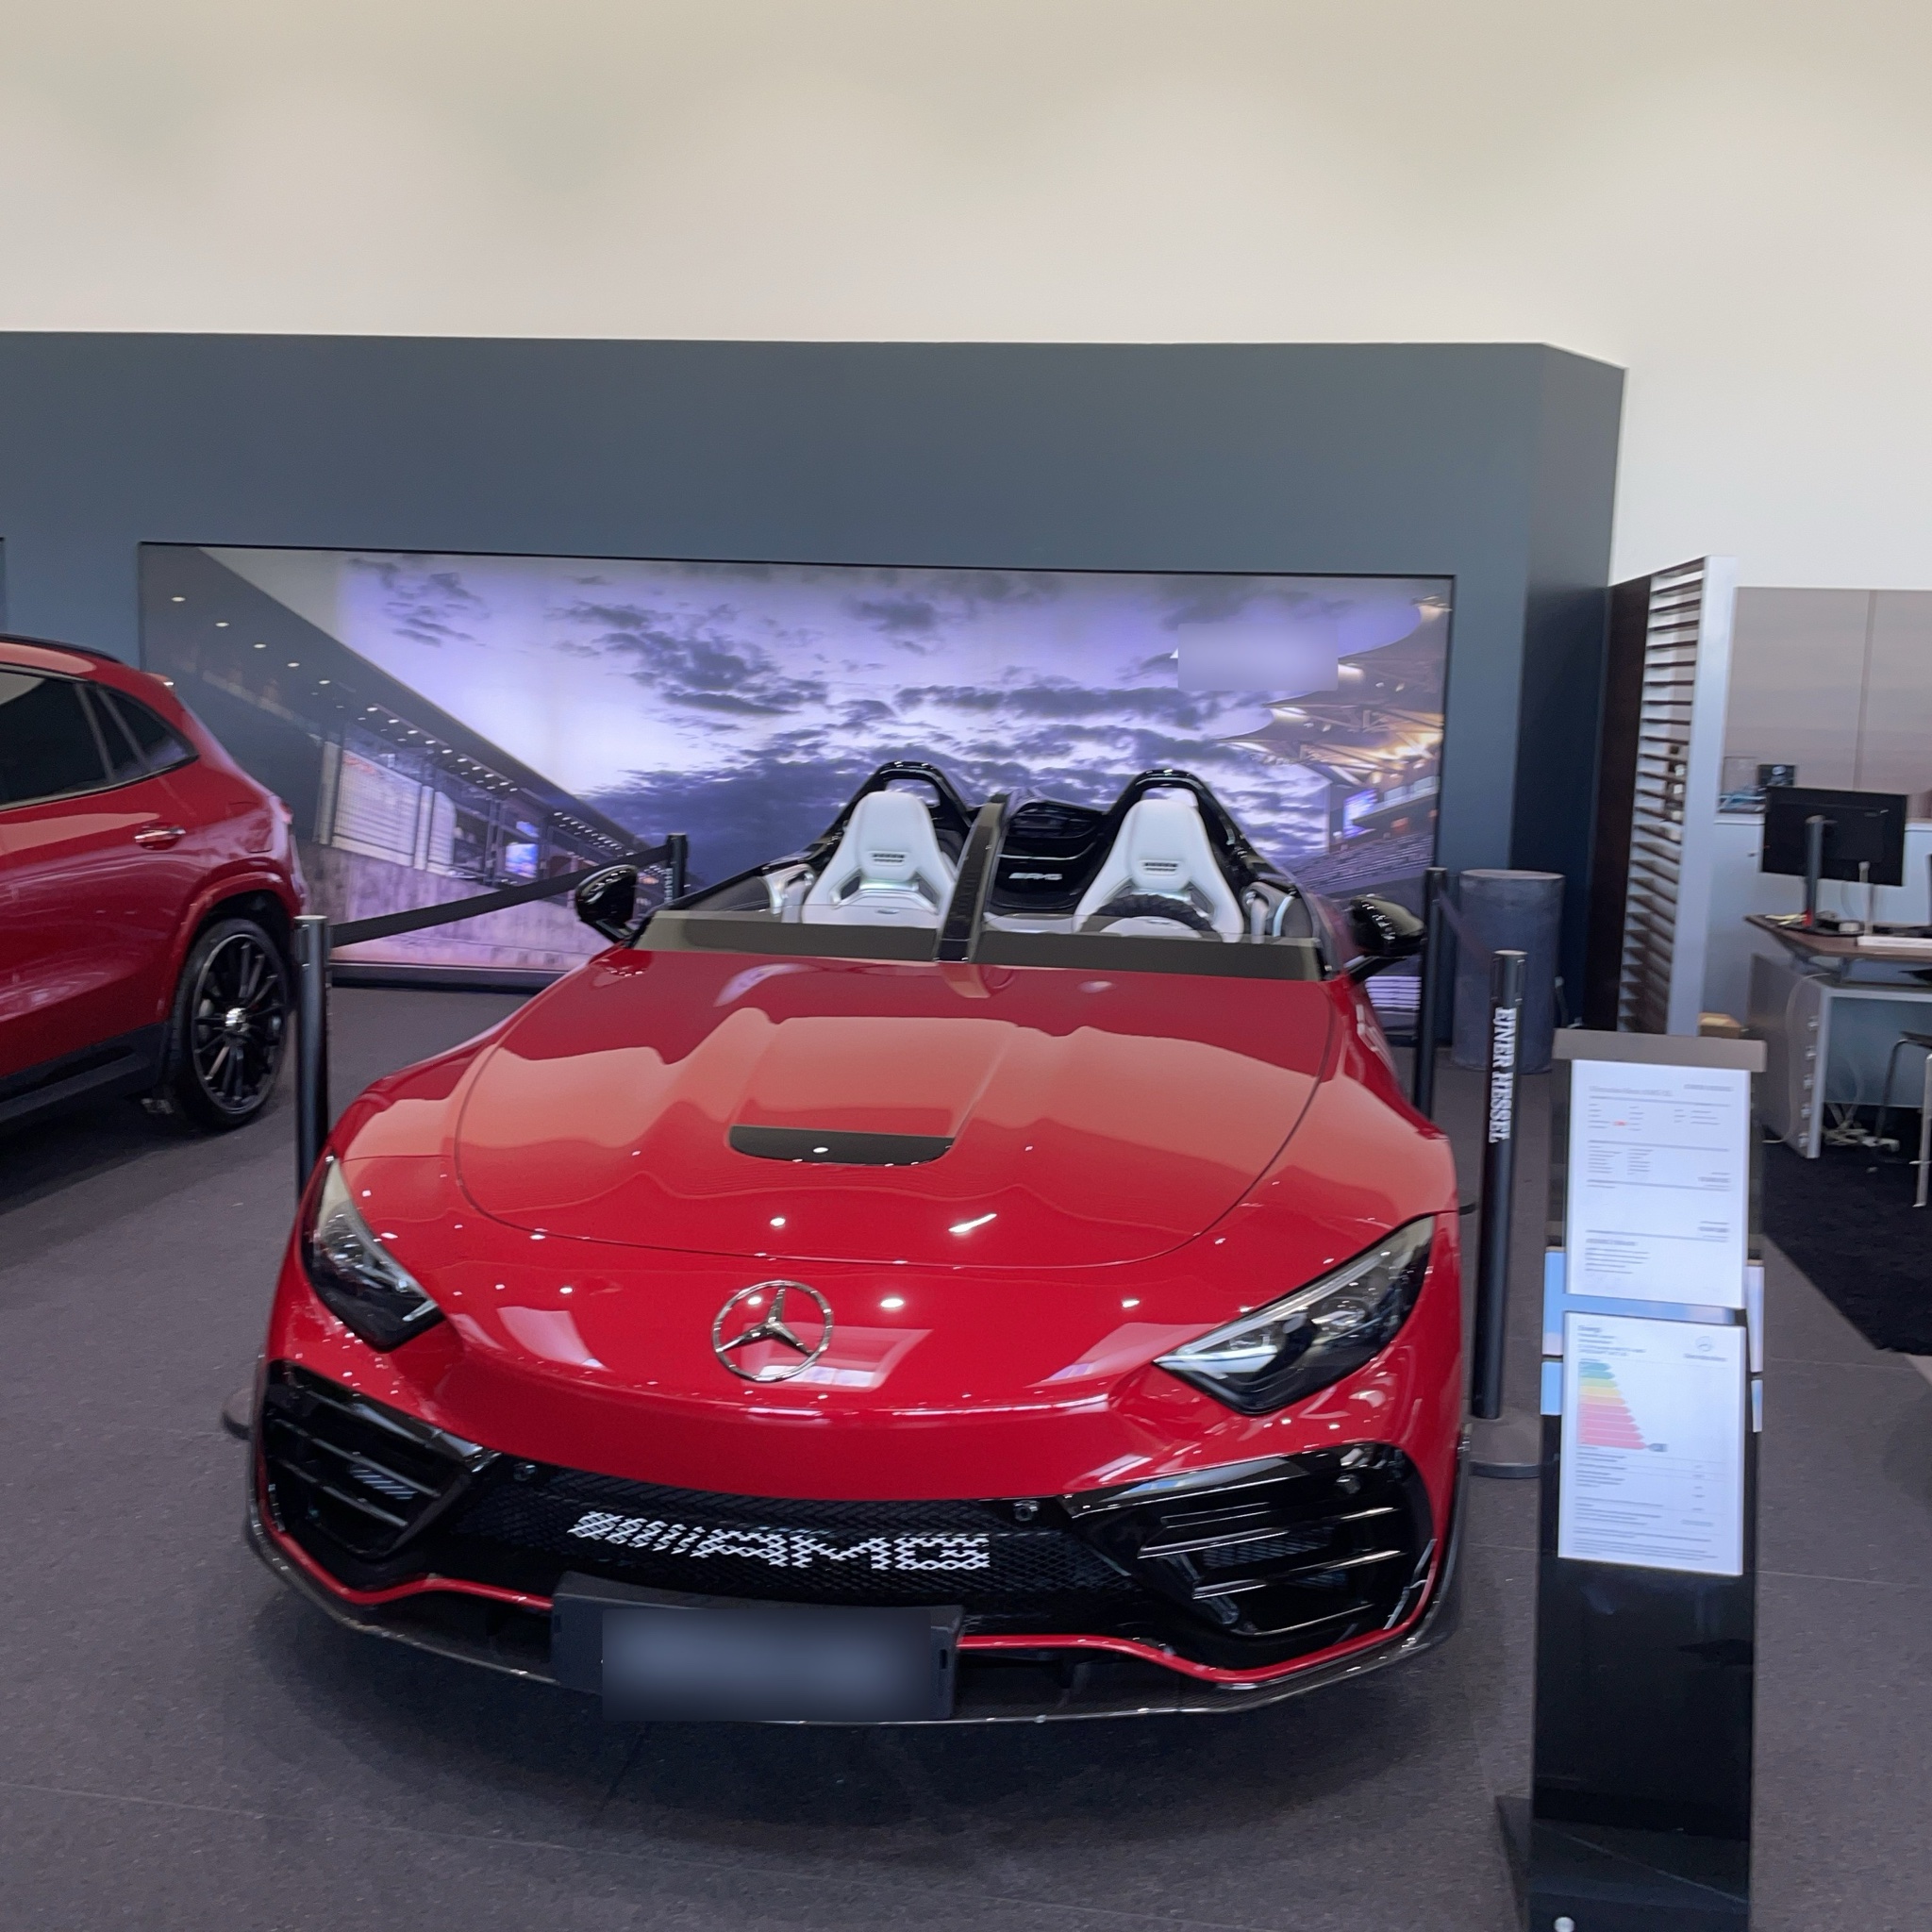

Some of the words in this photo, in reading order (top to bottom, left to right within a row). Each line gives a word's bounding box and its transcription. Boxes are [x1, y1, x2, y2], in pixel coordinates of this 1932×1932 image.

[1493, 1007, 1517, 1068] EJNER
[1489, 1072, 1513, 1143] HESSEL
[690, 1528, 990, 1571] AMG
